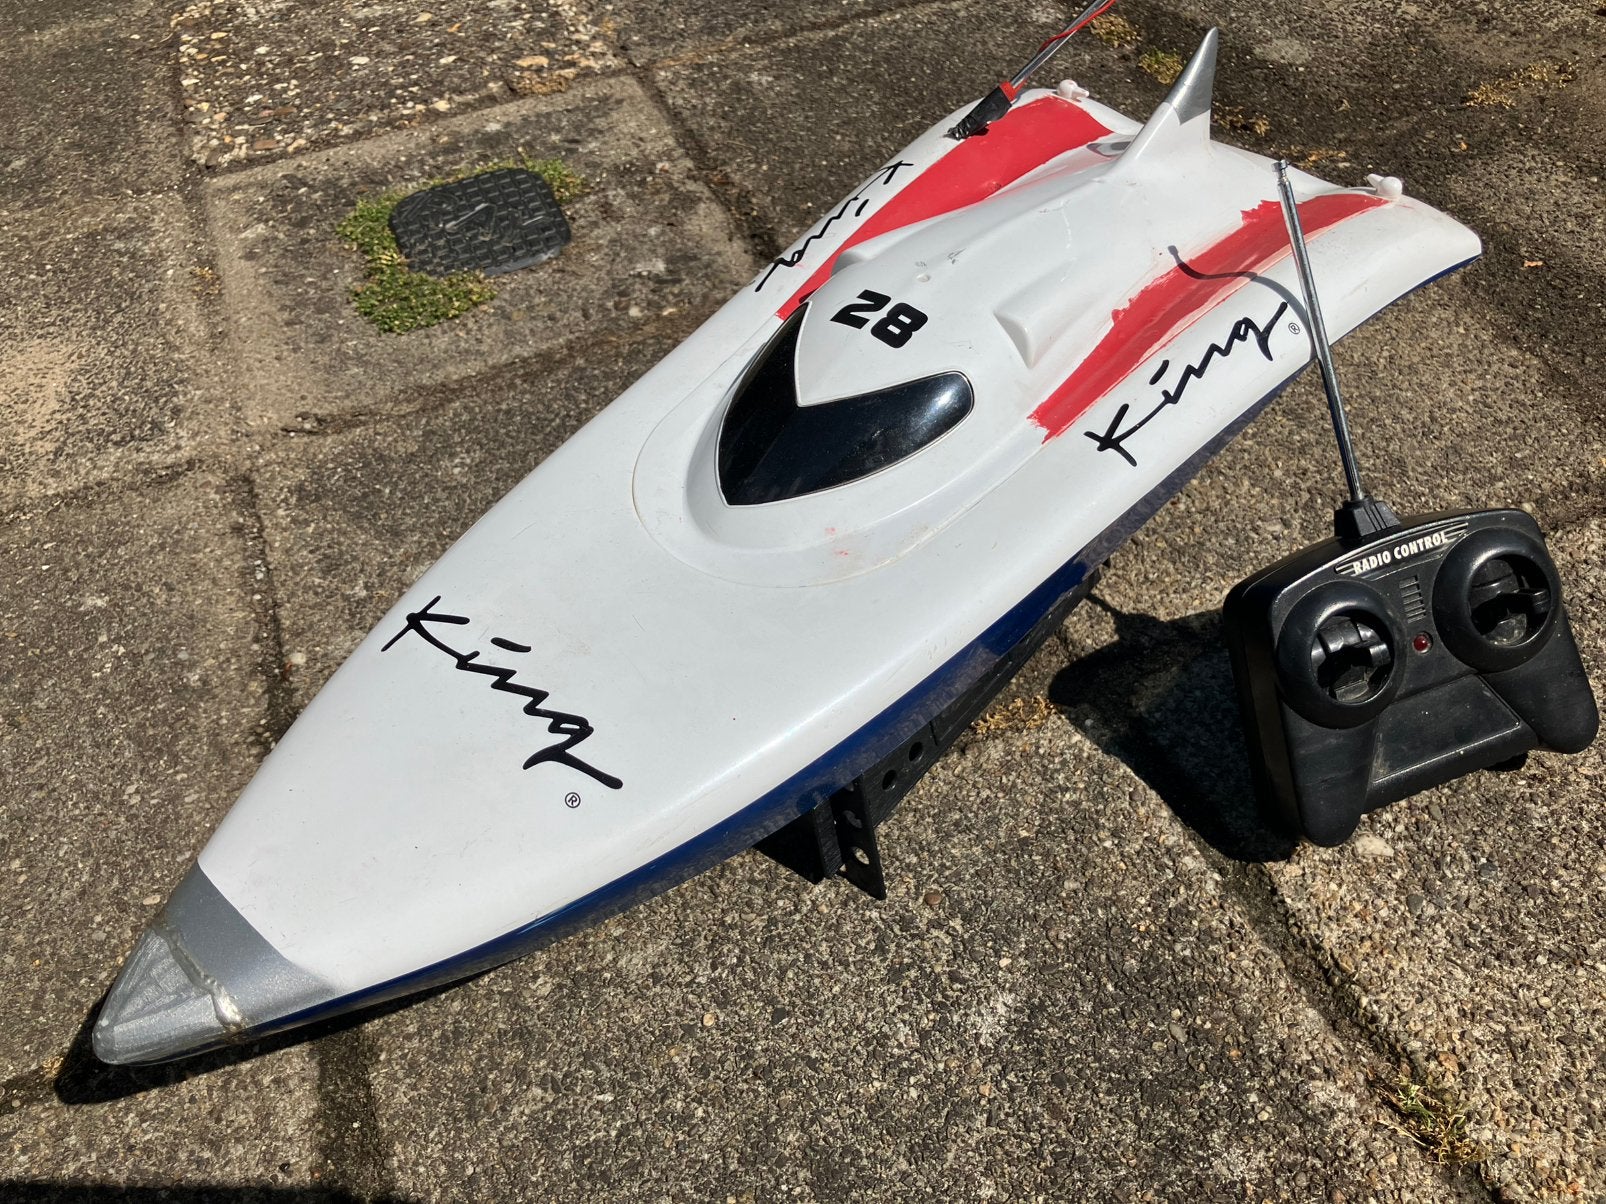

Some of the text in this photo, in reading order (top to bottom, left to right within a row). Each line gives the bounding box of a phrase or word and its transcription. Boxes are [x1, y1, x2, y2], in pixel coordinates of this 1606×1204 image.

[755, 160, 914, 292] King
[829, 289, 929, 349] 28
[1083, 301, 1288, 467] King
[1352, 531, 1448, 576] RADIO CONTROL
[380, 595, 624, 790] King
